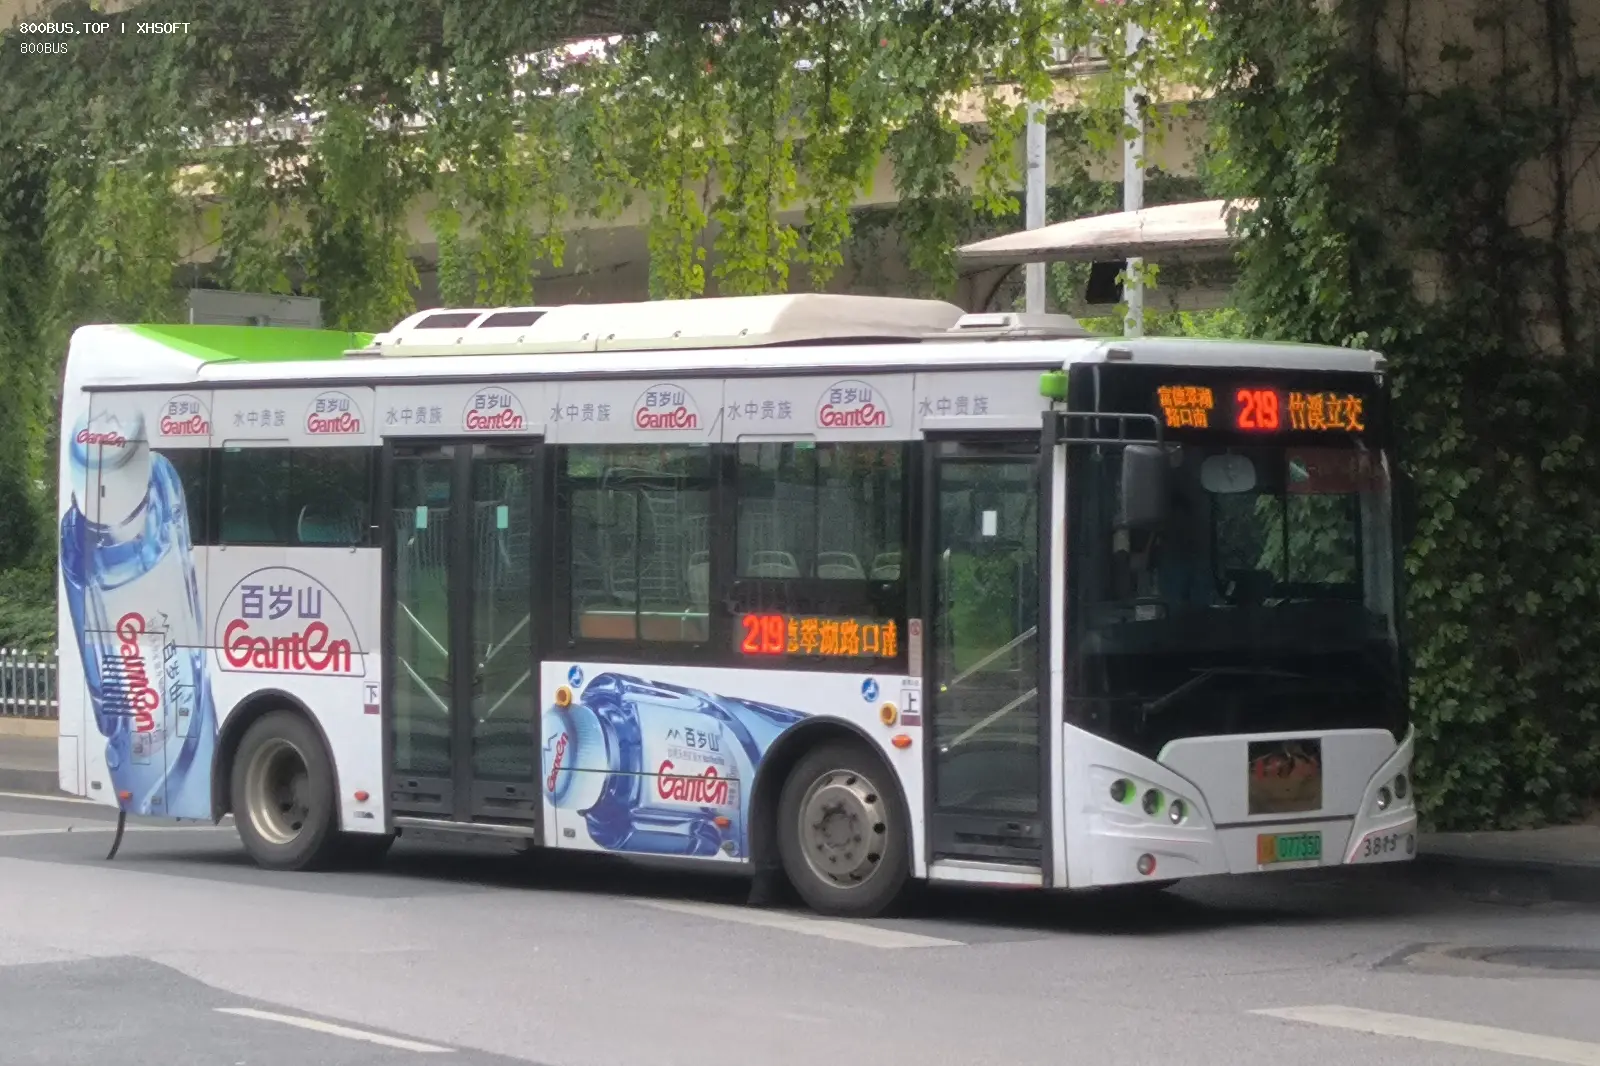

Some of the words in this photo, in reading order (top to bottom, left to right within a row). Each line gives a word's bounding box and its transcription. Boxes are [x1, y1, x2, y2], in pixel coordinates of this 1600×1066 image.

[315, 398, 349, 413] 百岁山
[475, 394, 512, 409] 百岁山
[645, 392, 685, 407] 百岁山
[830, 388, 872, 404] 百岁山
[169, 402, 200, 416] 百岁山
[386, 406, 442, 424] 水中贵族
[550, 403, 611, 422] 水中贵族
[727, 400, 792, 421] 水中贵族
[918, 396, 989, 416] 水中贵族
[1237, 390, 1279, 429] 219
[233, 410, 285, 428] 水中贵族
[1164, 407, 1209, 428] 路口南
[241, 585, 321, 620] 百岁山
[742, 615, 785, 653] 219
[366, 685, 378, 702] 下
[903, 693, 918, 713] 上
[685, 727, 719, 752] 百岁山
